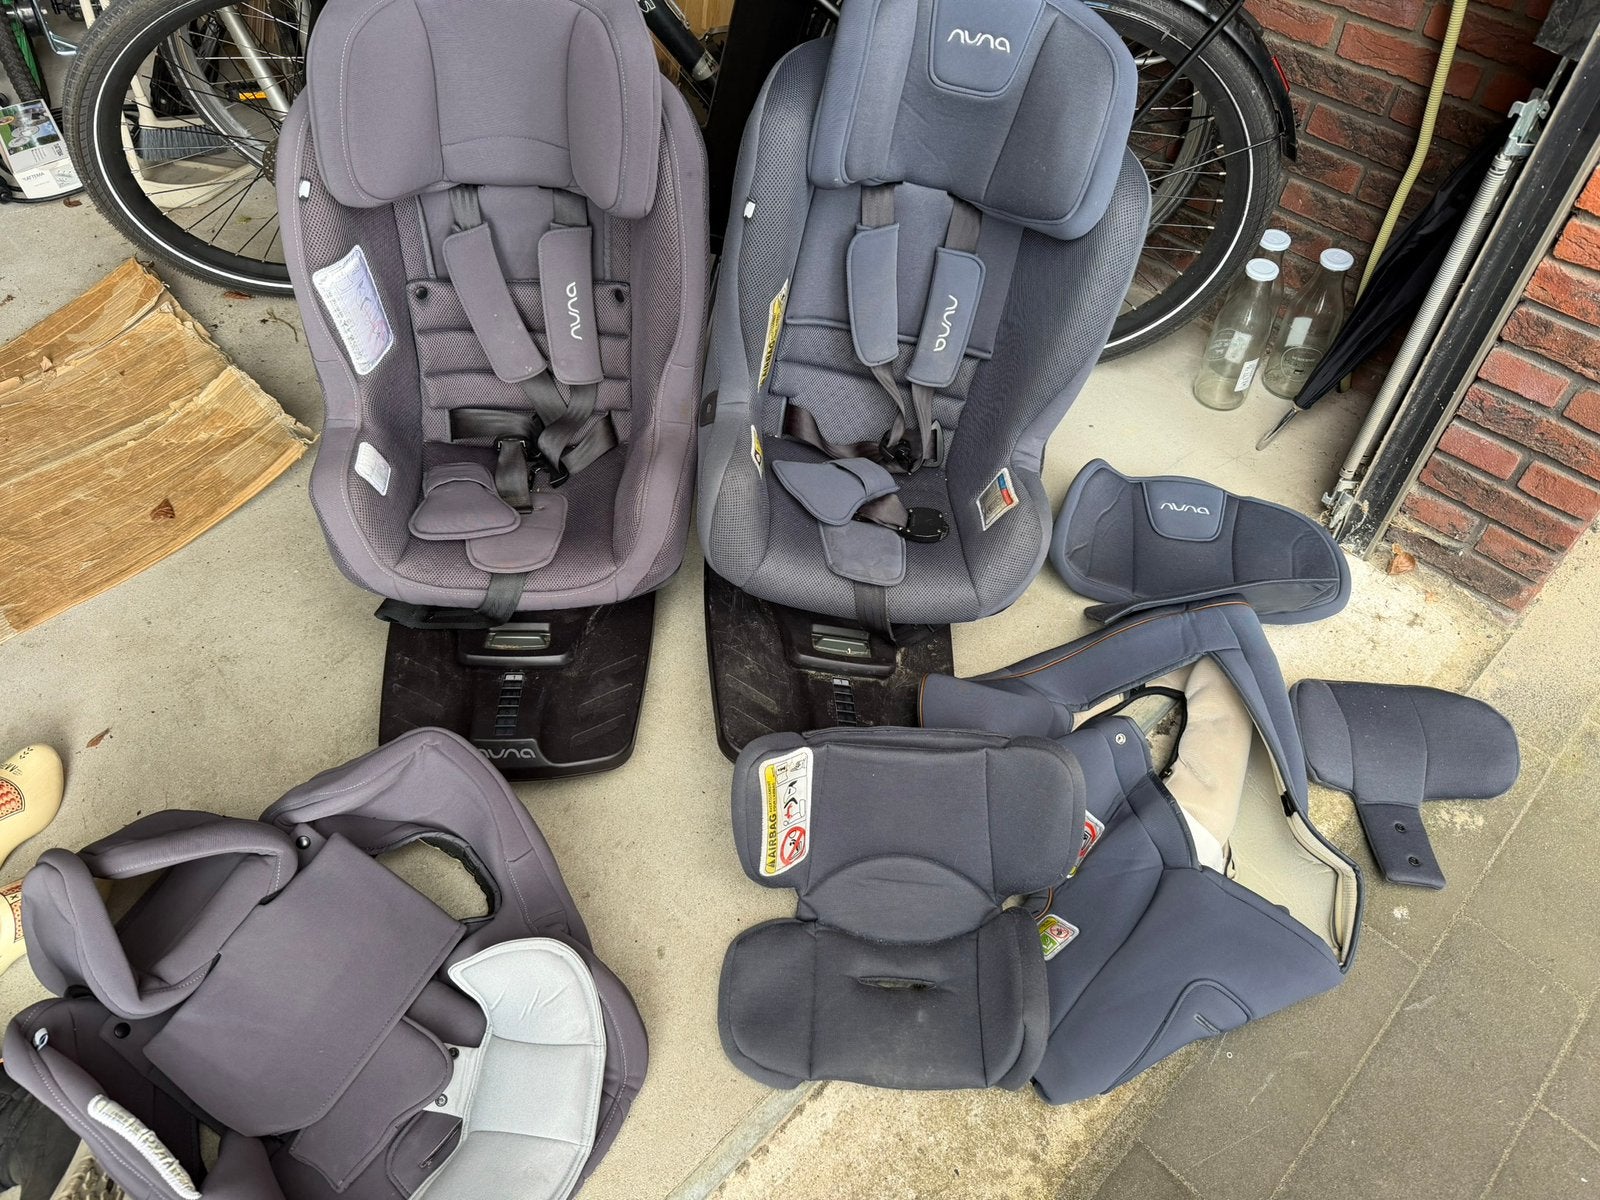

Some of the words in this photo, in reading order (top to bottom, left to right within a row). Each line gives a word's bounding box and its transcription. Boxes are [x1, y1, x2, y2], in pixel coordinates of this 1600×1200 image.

[947, 25, 1011, 54] nuna
[566, 281, 583, 340] nuna
[933, 294, 958, 352] nuna
[1160, 502, 1210, 515] nuna
[768, 814, 777, 858] AIRBAG
